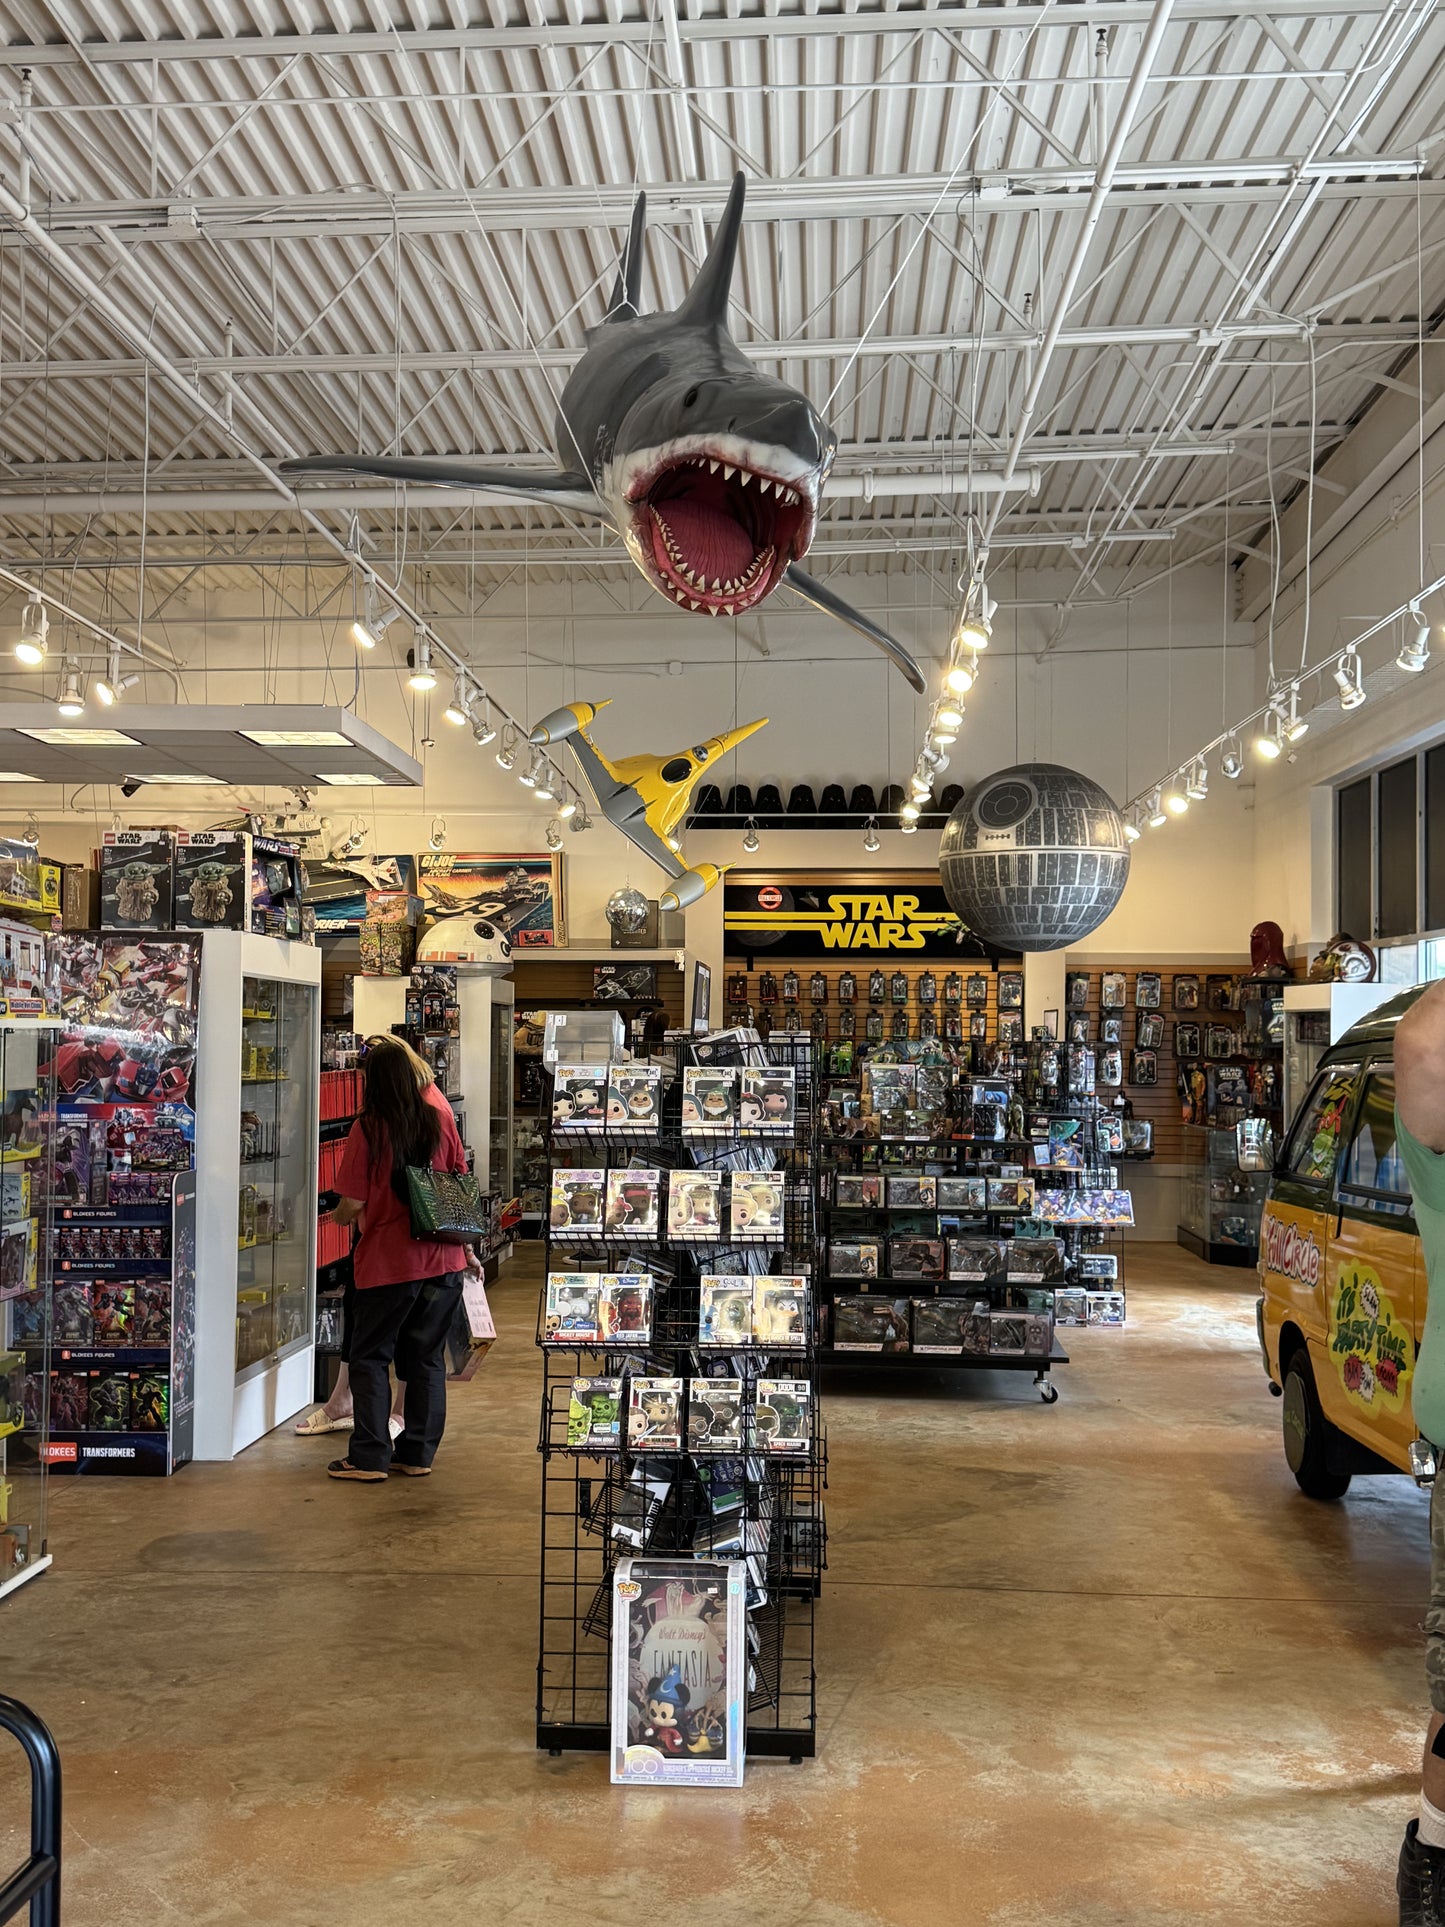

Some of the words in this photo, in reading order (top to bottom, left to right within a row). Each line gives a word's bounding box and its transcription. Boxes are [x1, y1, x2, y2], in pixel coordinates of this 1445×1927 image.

[253, 837, 282, 851] WARS
[828, 894, 920, 921] STAR
[818, 922, 926, 948] WARS
[82, 1447, 136, 1458] TRANSFORMERS
